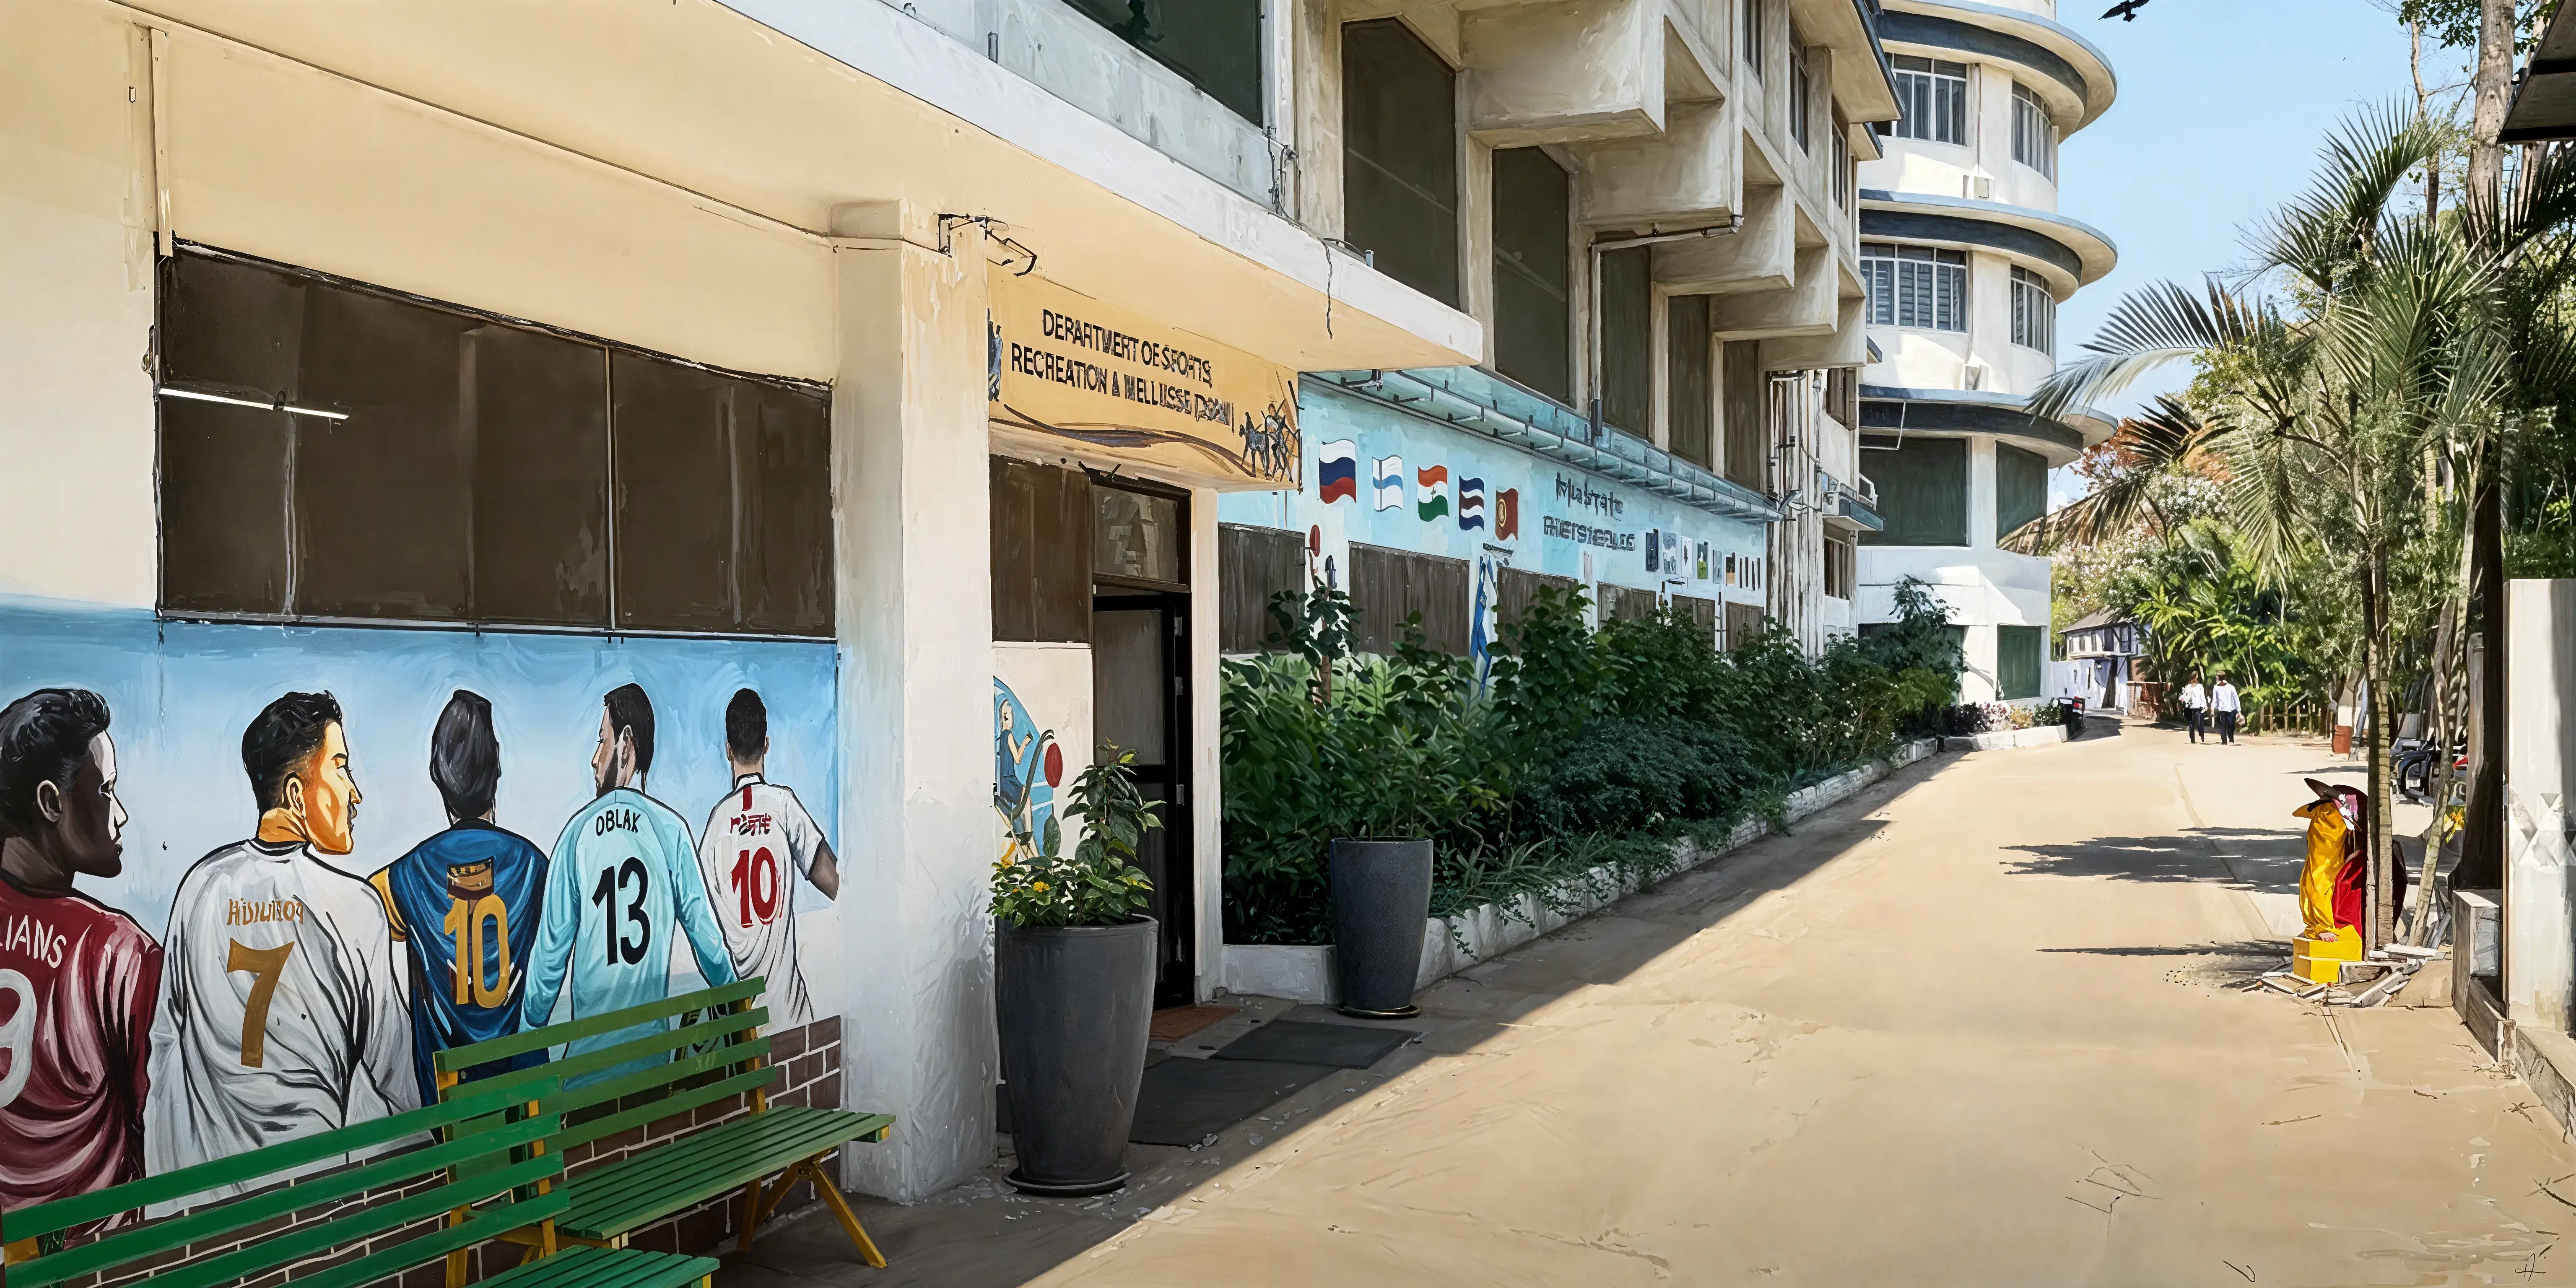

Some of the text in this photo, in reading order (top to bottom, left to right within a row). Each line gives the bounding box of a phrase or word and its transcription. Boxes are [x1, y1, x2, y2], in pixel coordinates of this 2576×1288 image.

[596, 808, 641, 836] OBLAK
[592, 856, 651, 966] 13
[731, 847, 777, 928] 10
[0, 915, 67, 969] IANS
[444, 893, 510, 1008] 10
[226, 937, 295, 1068] 7
